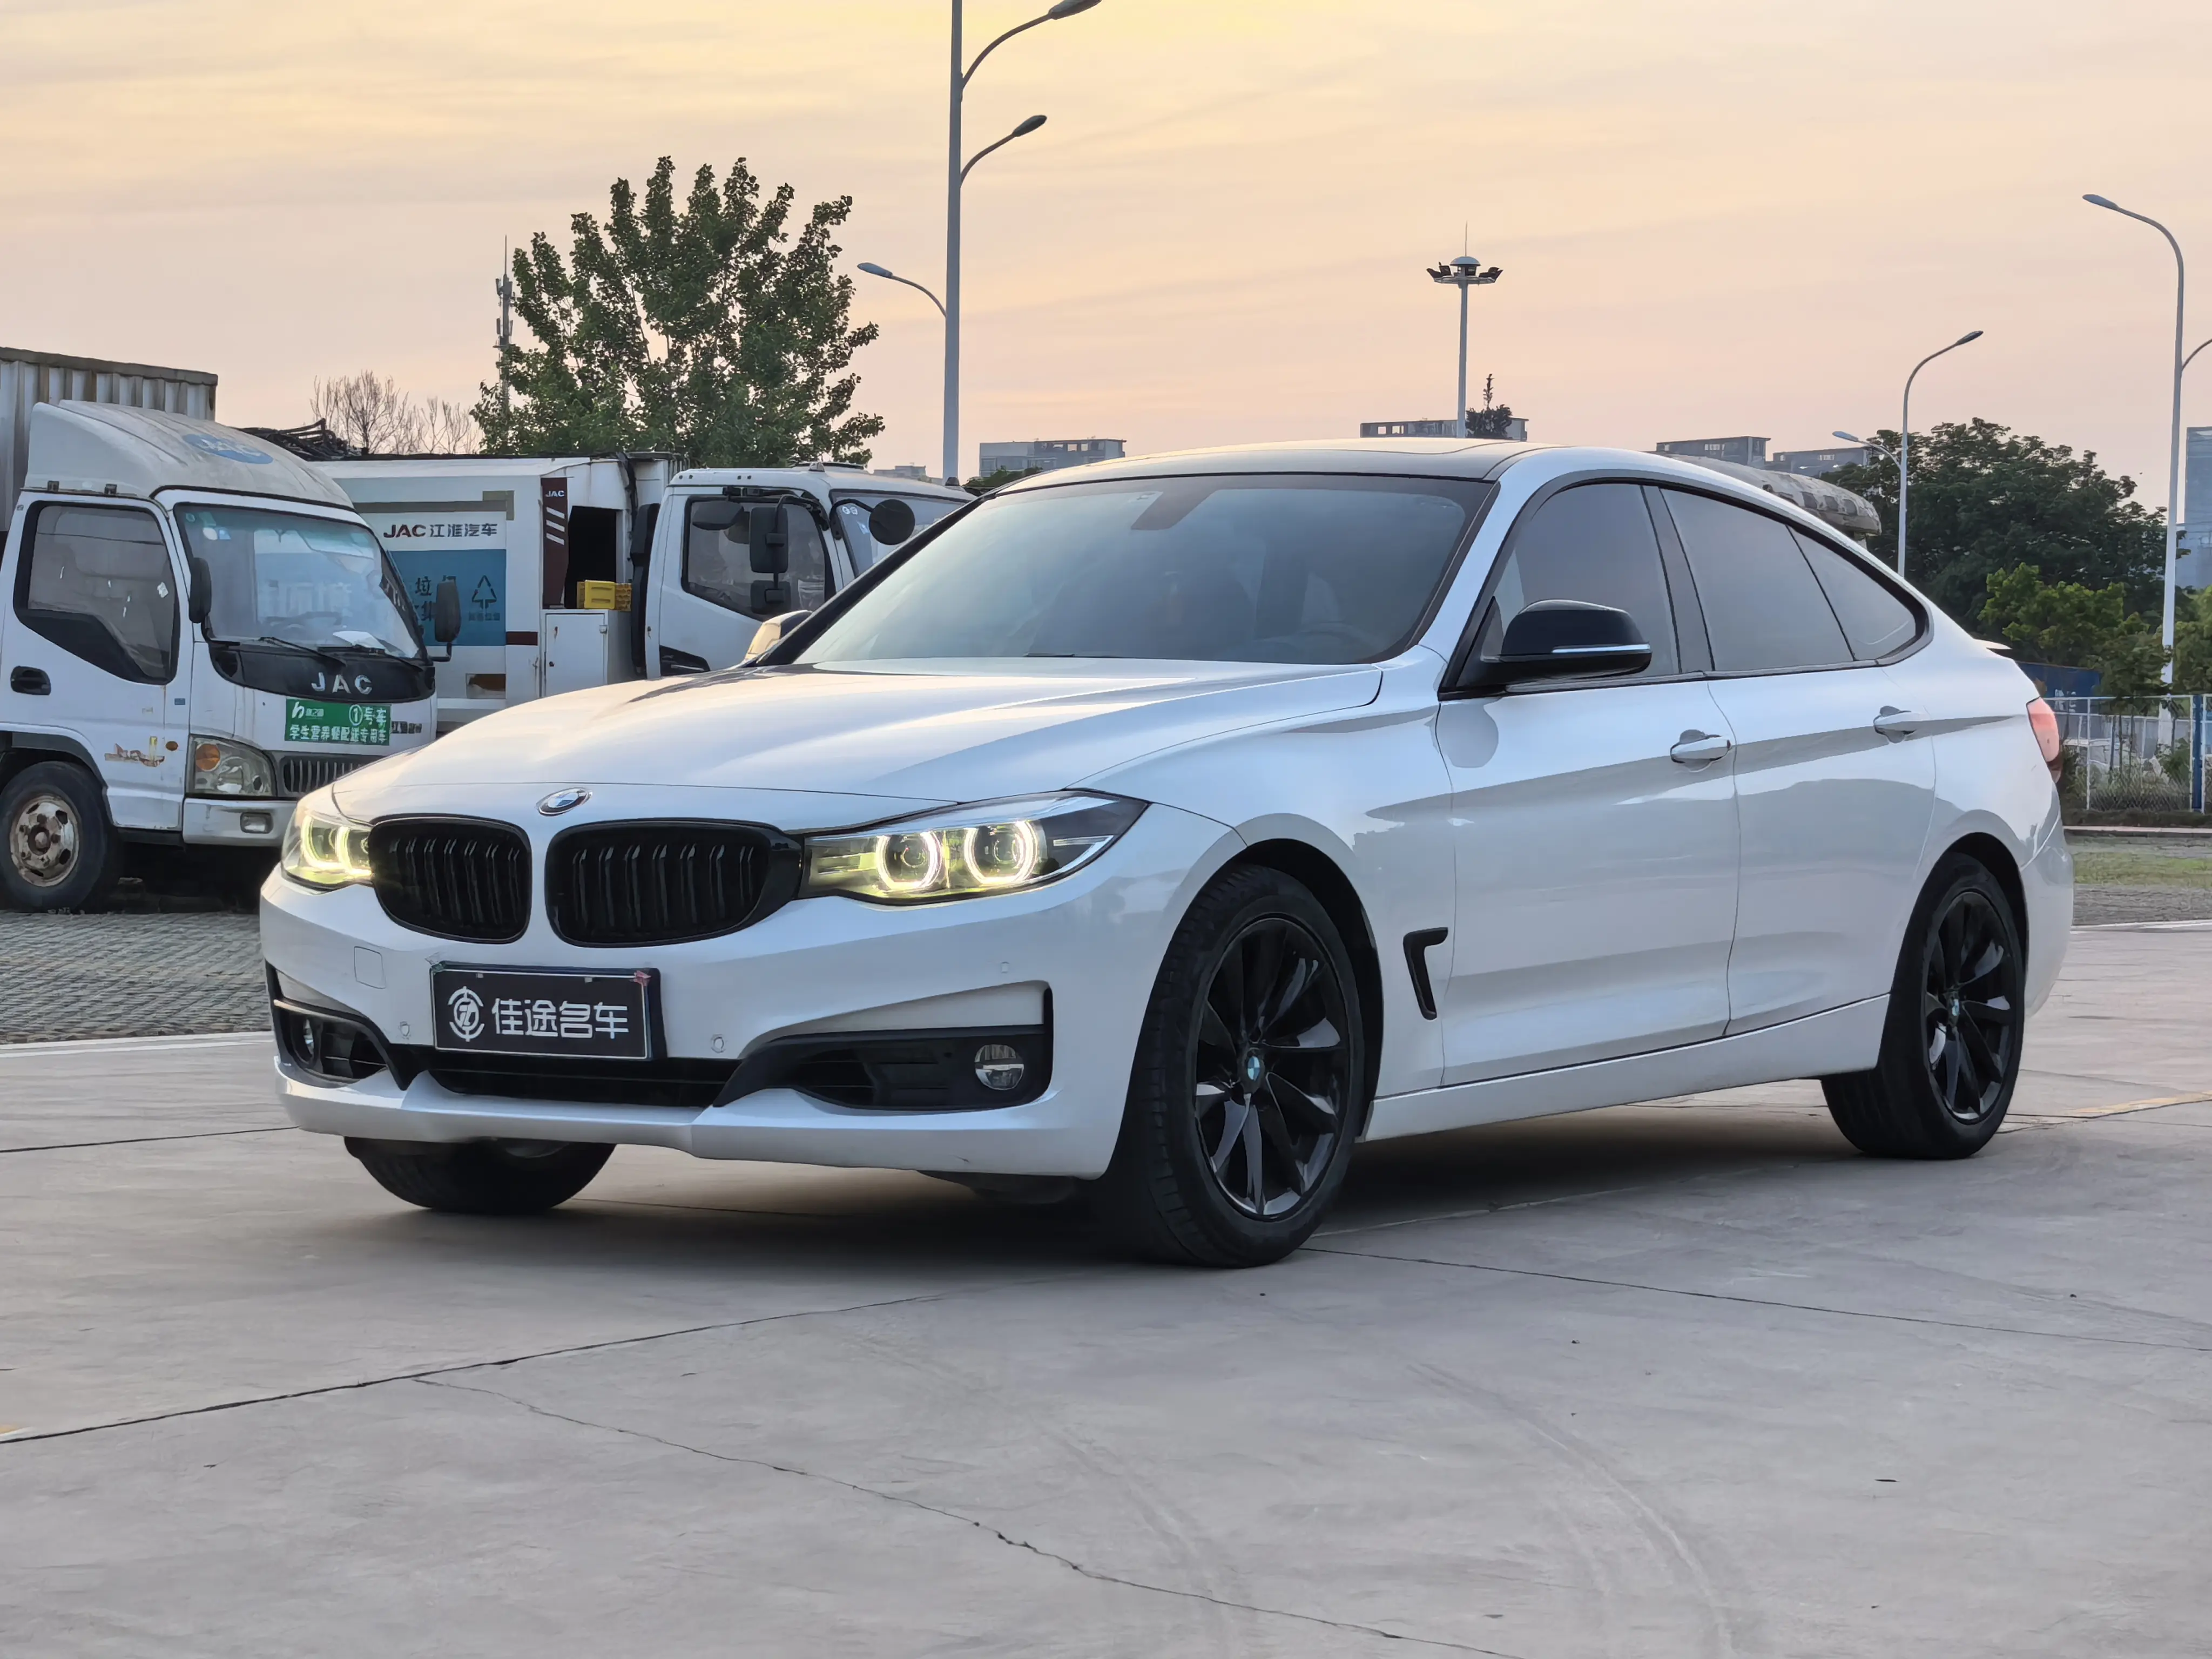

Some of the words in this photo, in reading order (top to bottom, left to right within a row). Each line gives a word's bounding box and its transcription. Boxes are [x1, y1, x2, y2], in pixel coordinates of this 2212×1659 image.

[383, 524, 427, 538] JAC
[428, 523, 498, 538] 江淮汽车
[311, 672, 373, 694] JAC
[491, 998, 629, 1039] 佳途名车
